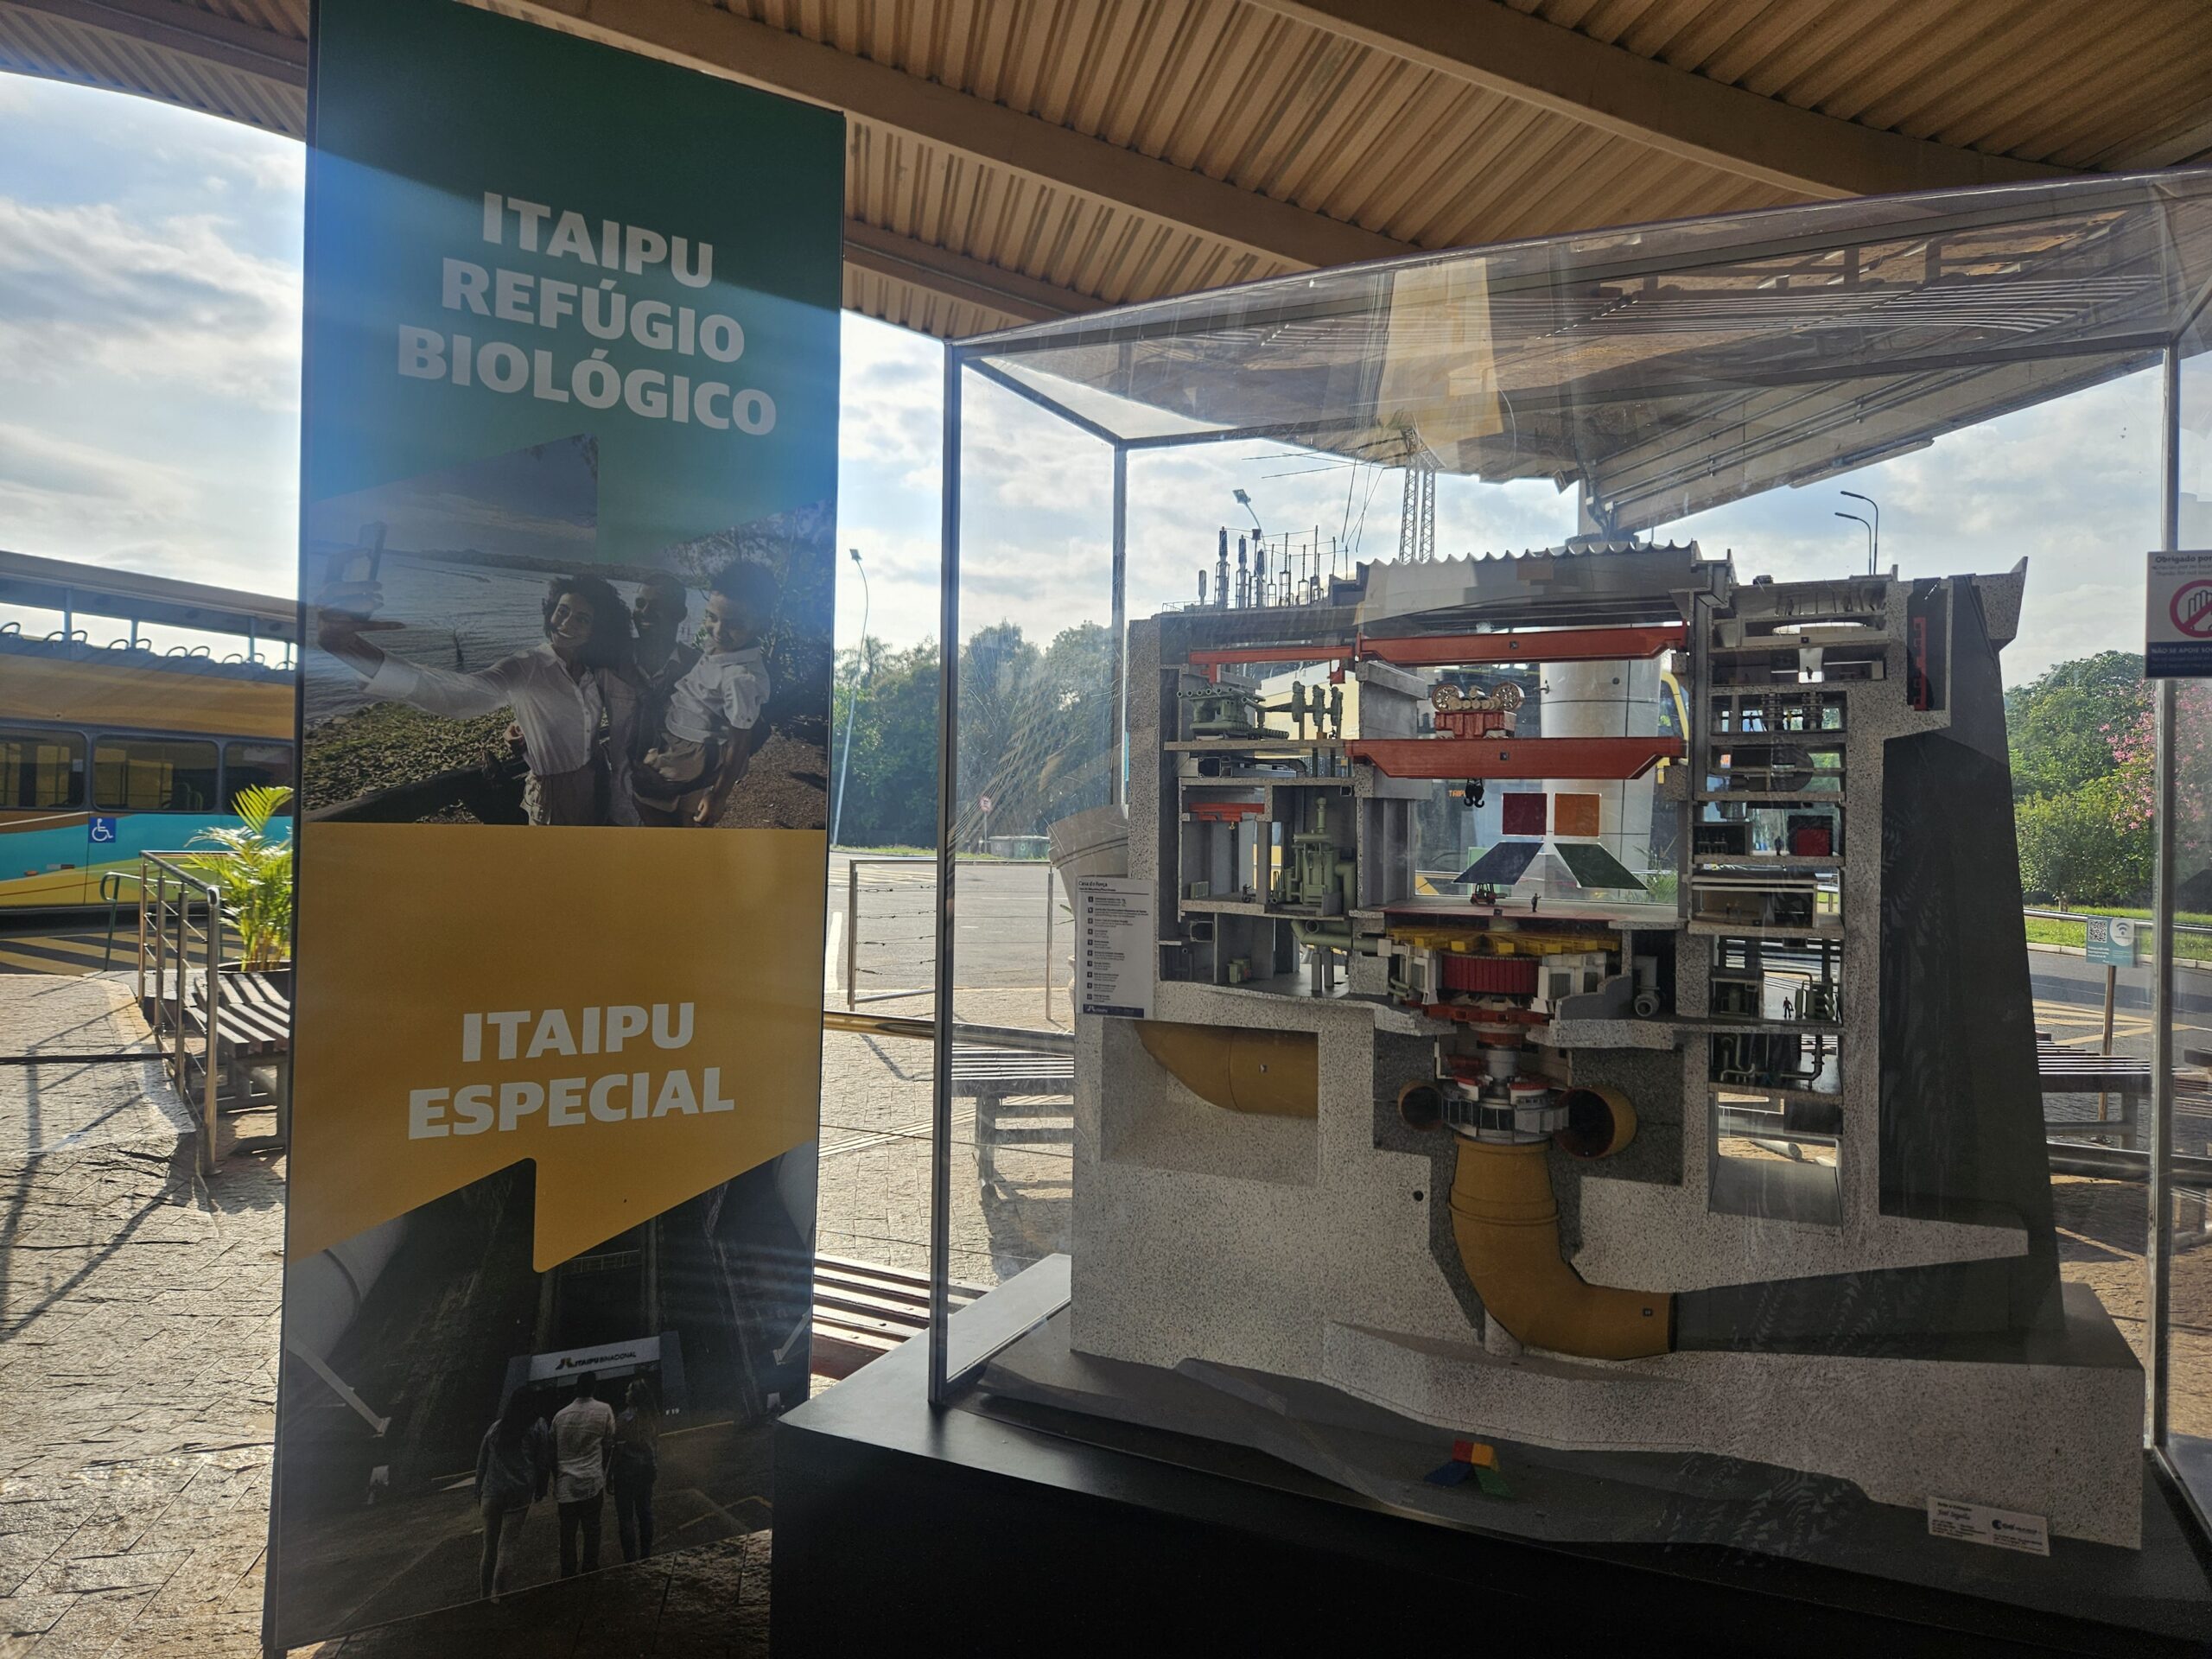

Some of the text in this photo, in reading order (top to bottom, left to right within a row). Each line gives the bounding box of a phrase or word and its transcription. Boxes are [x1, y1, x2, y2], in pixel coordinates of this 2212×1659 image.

[483, 191, 714, 288] ITAIPU
[442, 257, 745, 363] REFÚGIO
[397, 323, 777, 435] BIOLÓGICO
[2155, 555, 2196, 564] Obrigado
[462, 1001, 695, 1062] ITAIPU
[408, 1067, 734, 1140] ESPECIAL
[575, 1357, 599, 1366] ITAIPU
